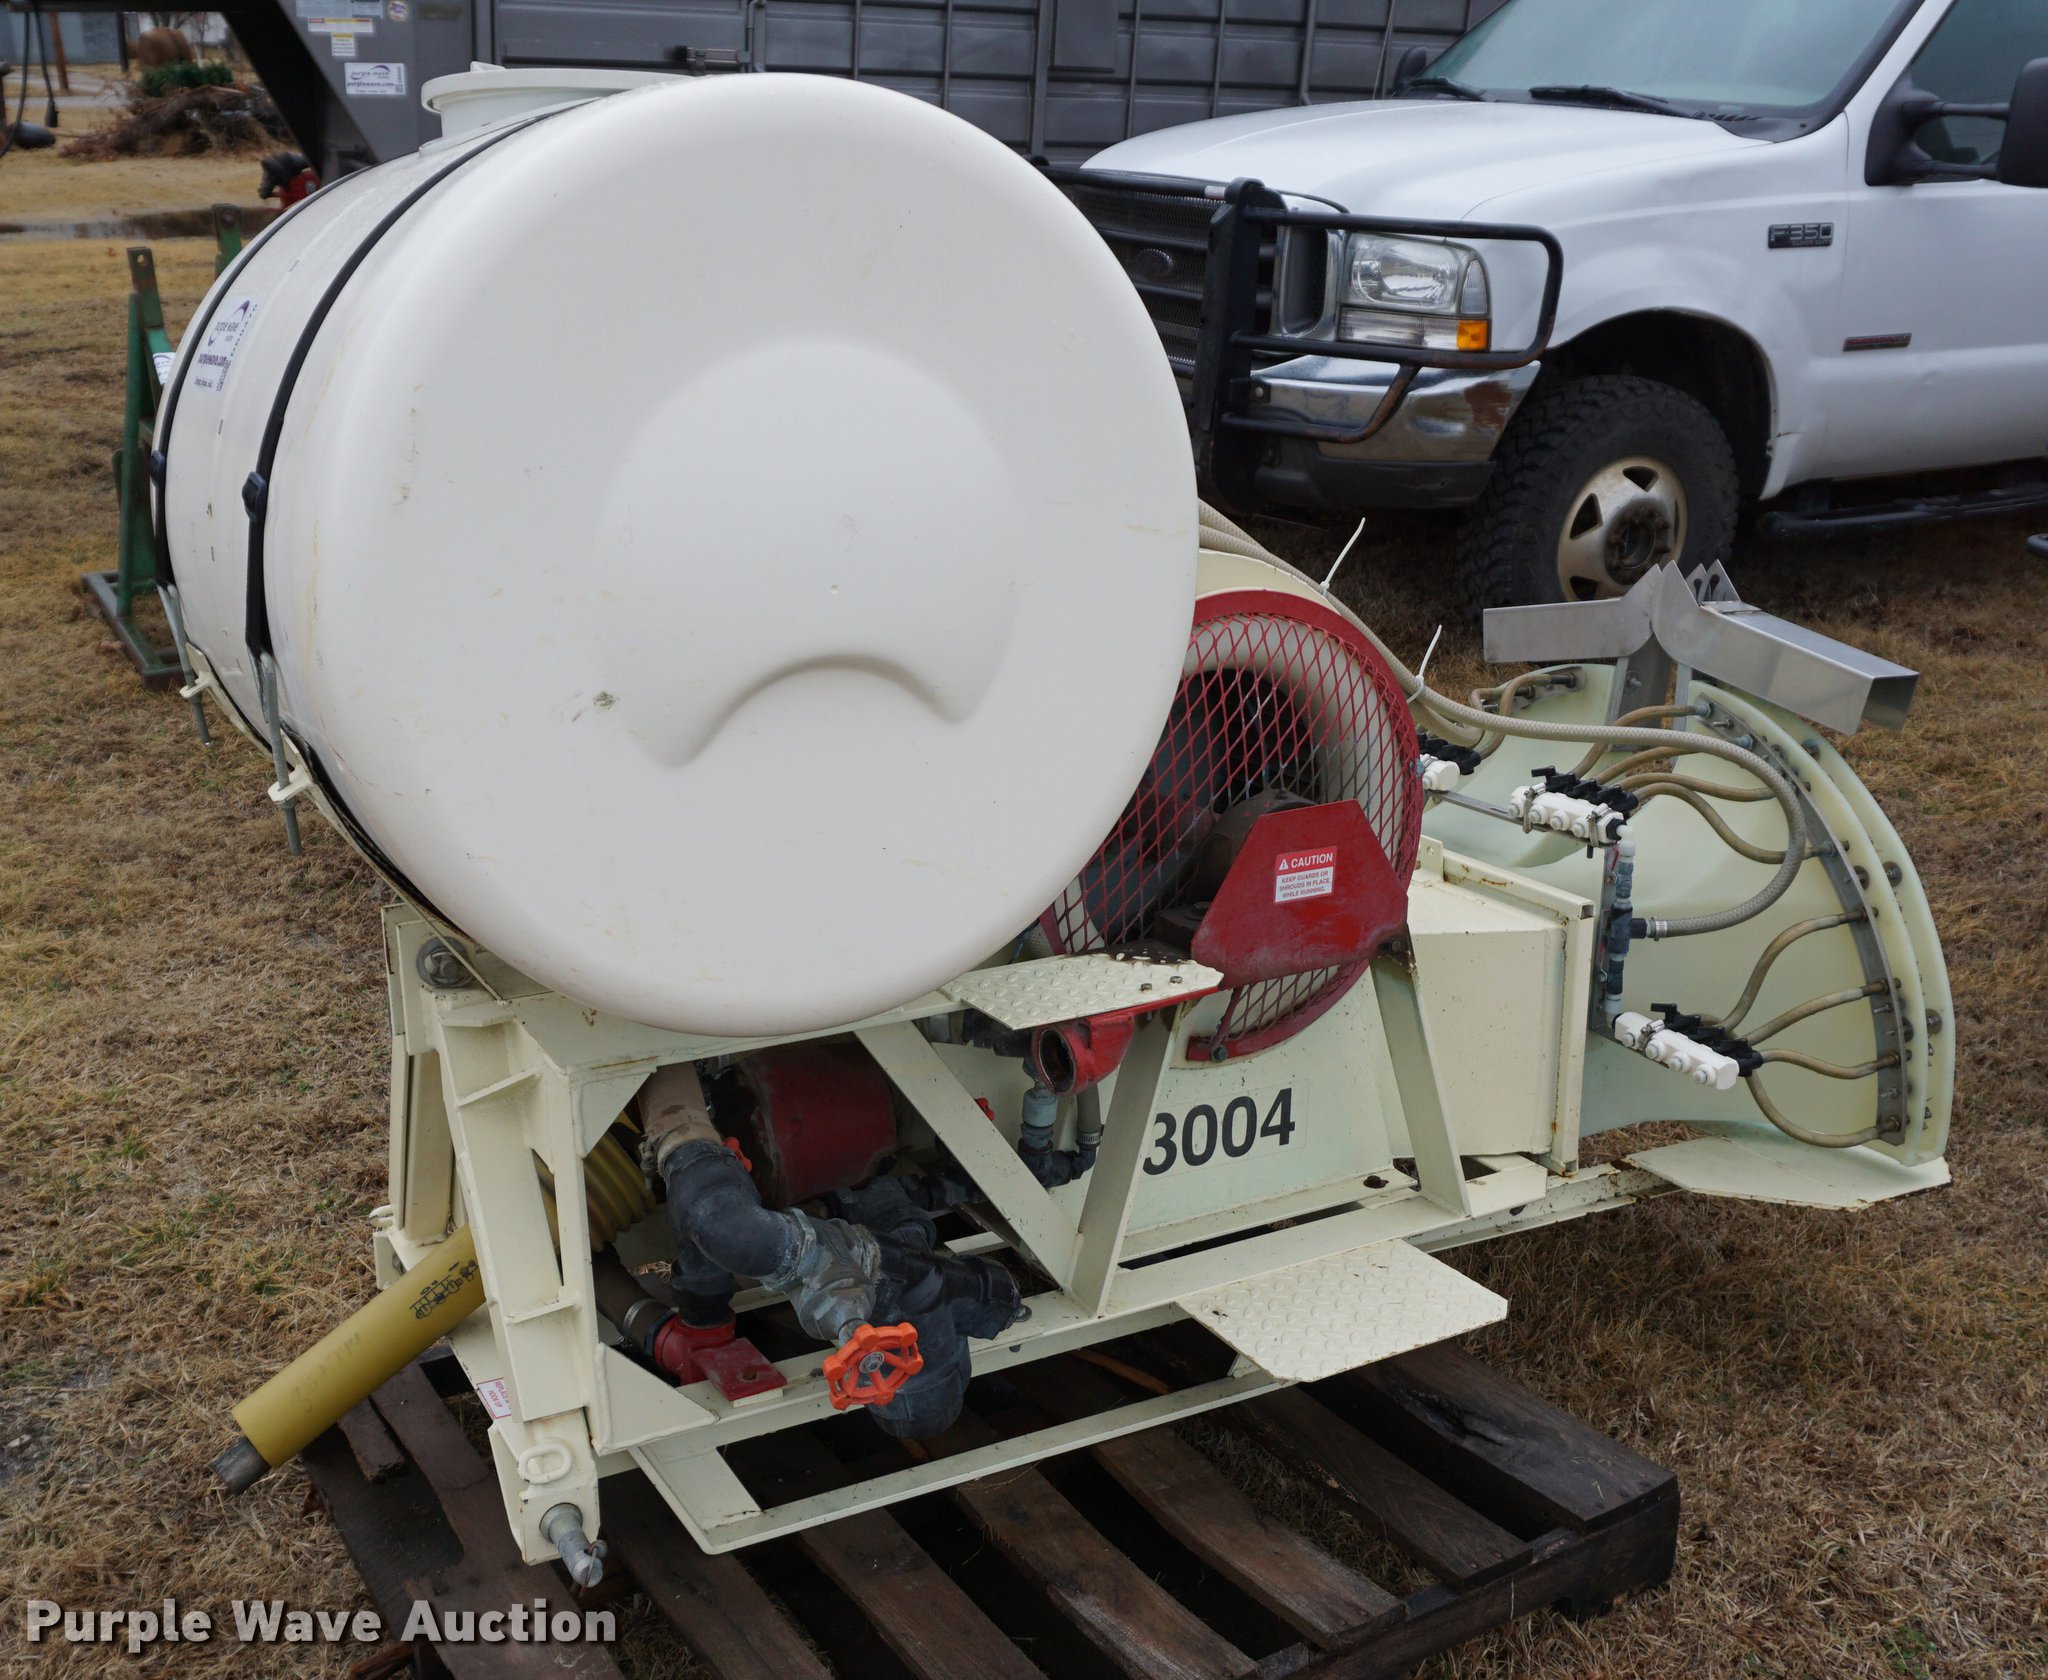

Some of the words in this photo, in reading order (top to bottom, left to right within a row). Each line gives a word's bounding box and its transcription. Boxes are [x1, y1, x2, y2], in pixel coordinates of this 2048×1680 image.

[1291, 852, 1333, 869] CAUTION
[1279, 883, 1306, 892] SHROUDS
[1312, 878, 1330, 886] PLACE
[1281, 875, 1297, 884] KEEP
[1297, 872, 1319, 882] GUARDS
[1282, 891, 1300, 899] WHILE
[1142, 1087, 1296, 1176] 3004
